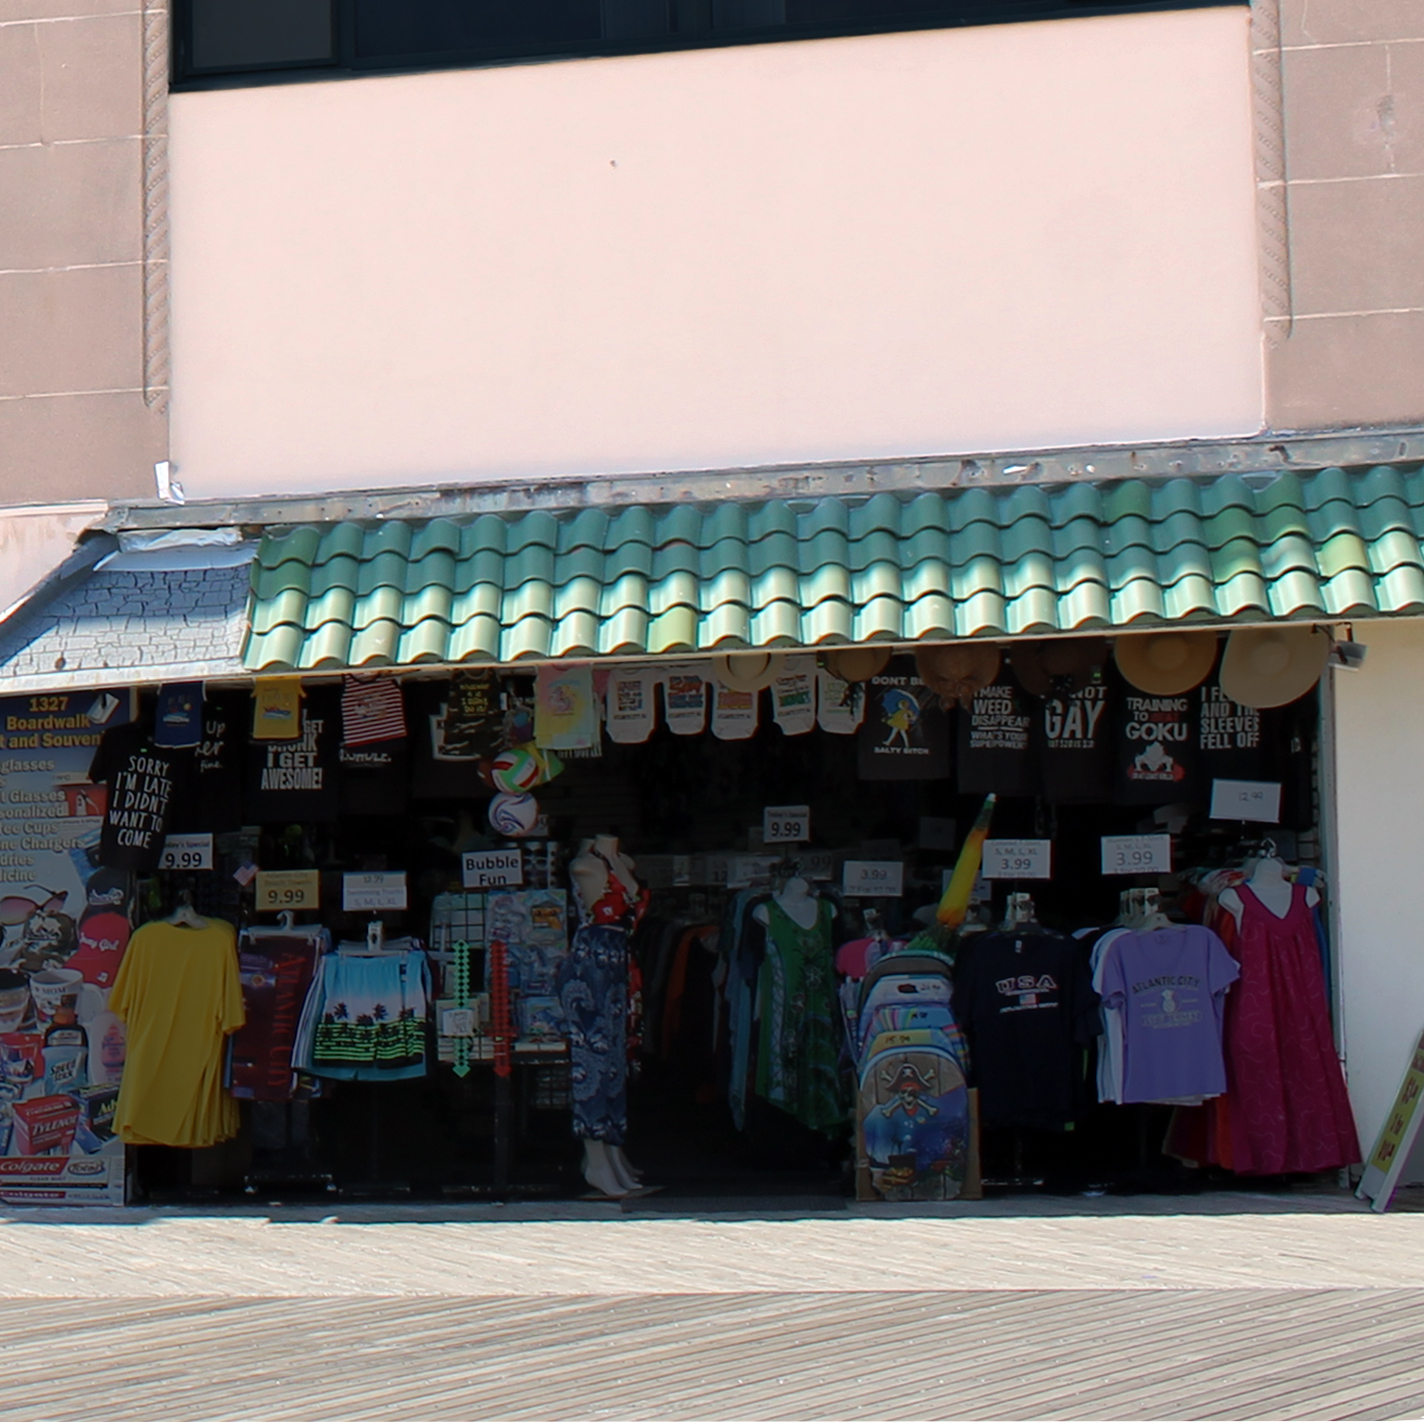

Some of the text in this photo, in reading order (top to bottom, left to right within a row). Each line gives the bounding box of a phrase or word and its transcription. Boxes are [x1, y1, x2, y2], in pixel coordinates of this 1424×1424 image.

[980, 685, 1013, 699] MAKE
[1201, 686, 1206, 702] I
[29, 697, 69, 712] 1327
[973, 699, 1013, 716] WEED
[1126, 696, 1188, 713] TRAINING
[1200, 702, 1230, 718] AND
[6, 714, 90, 730] Boardwalk
[971, 714, 1031, 728] DISAPPEAR
[1045, 699, 1105, 739] GAY
[1133, 711, 1149, 722] TO
[1200, 716, 1260, 733] SLEEVES
[205, 720, 226, 738] Up
[303, 719, 324, 733] GET
[1125, 722, 1188, 741] GOKU
[9, 731, 39, 747] and
[1200, 732, 1260, 749] FELL OFF
[128, 755, 170, 776] SORRY
[267, 752, 317, 767] I GET
[115, 771, 173, 798] I'M LATE
[261, 768, 323, 790] AWESOME!
[11, 789, 65, 803] Glasses
[114, 791, 119, 807] I
[109, 809, 163, 832] WANT TO
[24, 822, 58, 837] Cups
[771, 822, 802, 837] 9.99
[21, 836, 85, 852] Chargers
[117, 830, 152, 849] COME
[165, 852, 202, 868] 9.99
[466, 856, 519, 871] Bubble
[1000, 858, 1032, 870] 3.99
[1117, 851, 1154, 866] 3.99
[479, 873, 507, 886] Fun
[860, 869, 887, 881] 3.99
[268, 889, 305, 904] 9.99
[995, 974, 1057, 994] USA
[1132, 975, 1201, 994] ATLANTIC CITY
[32, 1114, 78, 1135] TYLENOL
[0, 1160, 61, 1174] Colgate
